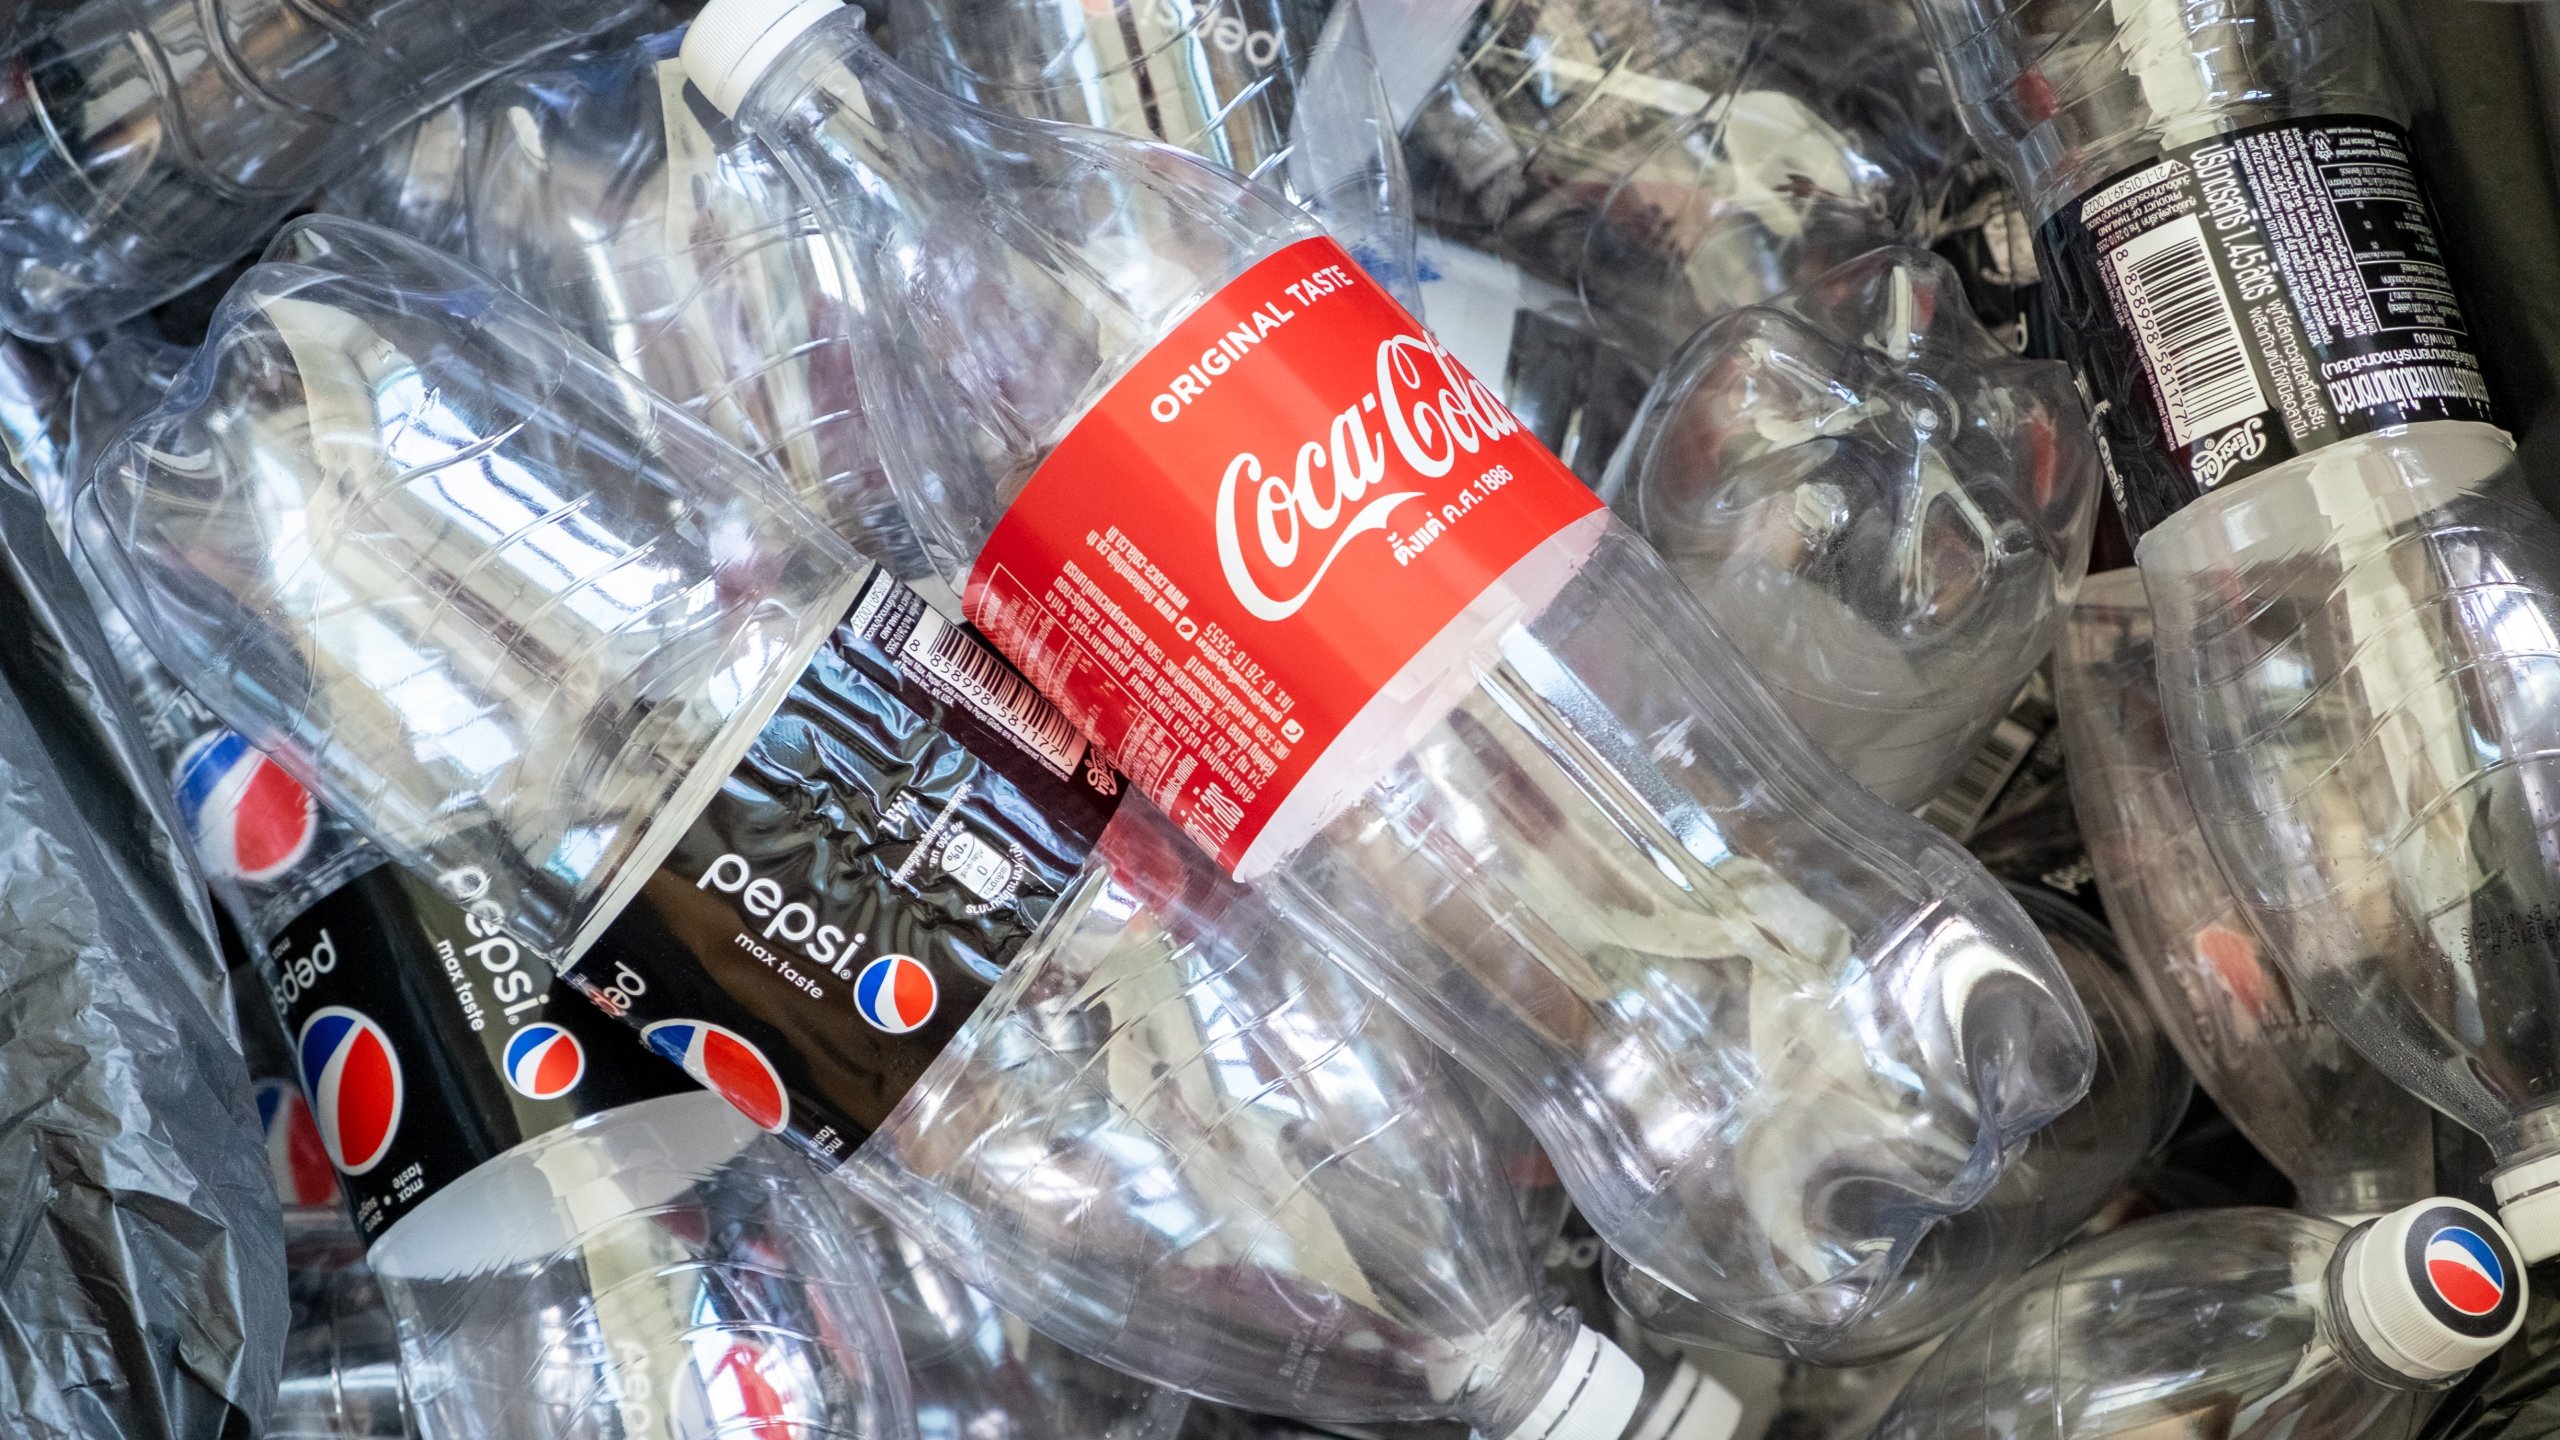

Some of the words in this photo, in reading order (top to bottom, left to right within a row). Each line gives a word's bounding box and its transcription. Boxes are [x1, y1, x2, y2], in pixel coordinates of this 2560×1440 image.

[2079, 163, 2168, 217] 21-1-01549-1-0023
[2143, 188, 2183, 213] PRODUCT
[2184, 143, 2256, 230] ปริมาตรสุทธิ
[2097, 212, 2131, 236] THAILAND
[2221, 225, 2267, 269] 1.45
[2234, 262, 2278, 301] ลิตร
[1149, 300, 1295, 424] ORIGINAL
[1284, 263, 1355, 308] TASTE
[2121, 270, 2161, 346] 858998
[2150, 350, 2191, 424] 581177
[1214, 331, 1516, 622] Coca-Cola
[1386, 511, 1446, 568] ตั้งแต่
[1086, 530, 1177, 622] www.thainamthip.co.th
[1105, 526, 1188, 609] www.coca-cola.co.th
[1044, 589, 1067, 617] จำกัด
[1053, 575, 1100, 624] ส่วนประกอบ
[879, 611, 901, 639] THAILAND
[1202, 621, 1275, 695] 0-2616-5555
[928, 653, 994, 707] 858998
[997, 707, 1057, 758] 581177
[1210, 706, 1230, 729] 10%
[1274, 687, 1295, 713] โทร.
[1172, 718, 1201, 749] บริษัท
[1213, 735, 1231, 756] ชั้น
[1253, 721, 1275, 746] 338)
[1197, 743, 1255, 802] สำนักงานใหญ่
[1231, 753, 1250, 774] หมู่
[1246, 768, 1267, 790] 214
[882, 789, 920, 830] 1.45
[1190, 778, 1246, 829] ลิตร
[933, 829, 953, 849] 200
[949, 816, 967, 834] ต่อ
[976, 863, 988, 876] 0
[695, 852, 868, 982] pepsi
[272, 928, 338, 1015] peps
[436, 938, 466, 981] max
[454, 978, 486, 1033] taste
[733, 930, 779, 969] max
[776, 962, 827, 1001] taste
[805, 1122, 838, 1153] taste
[816, 1133, 845, 1160] max
[392, 1162, 422, 1189] taste
[396, 1177, 424, 1202] max
